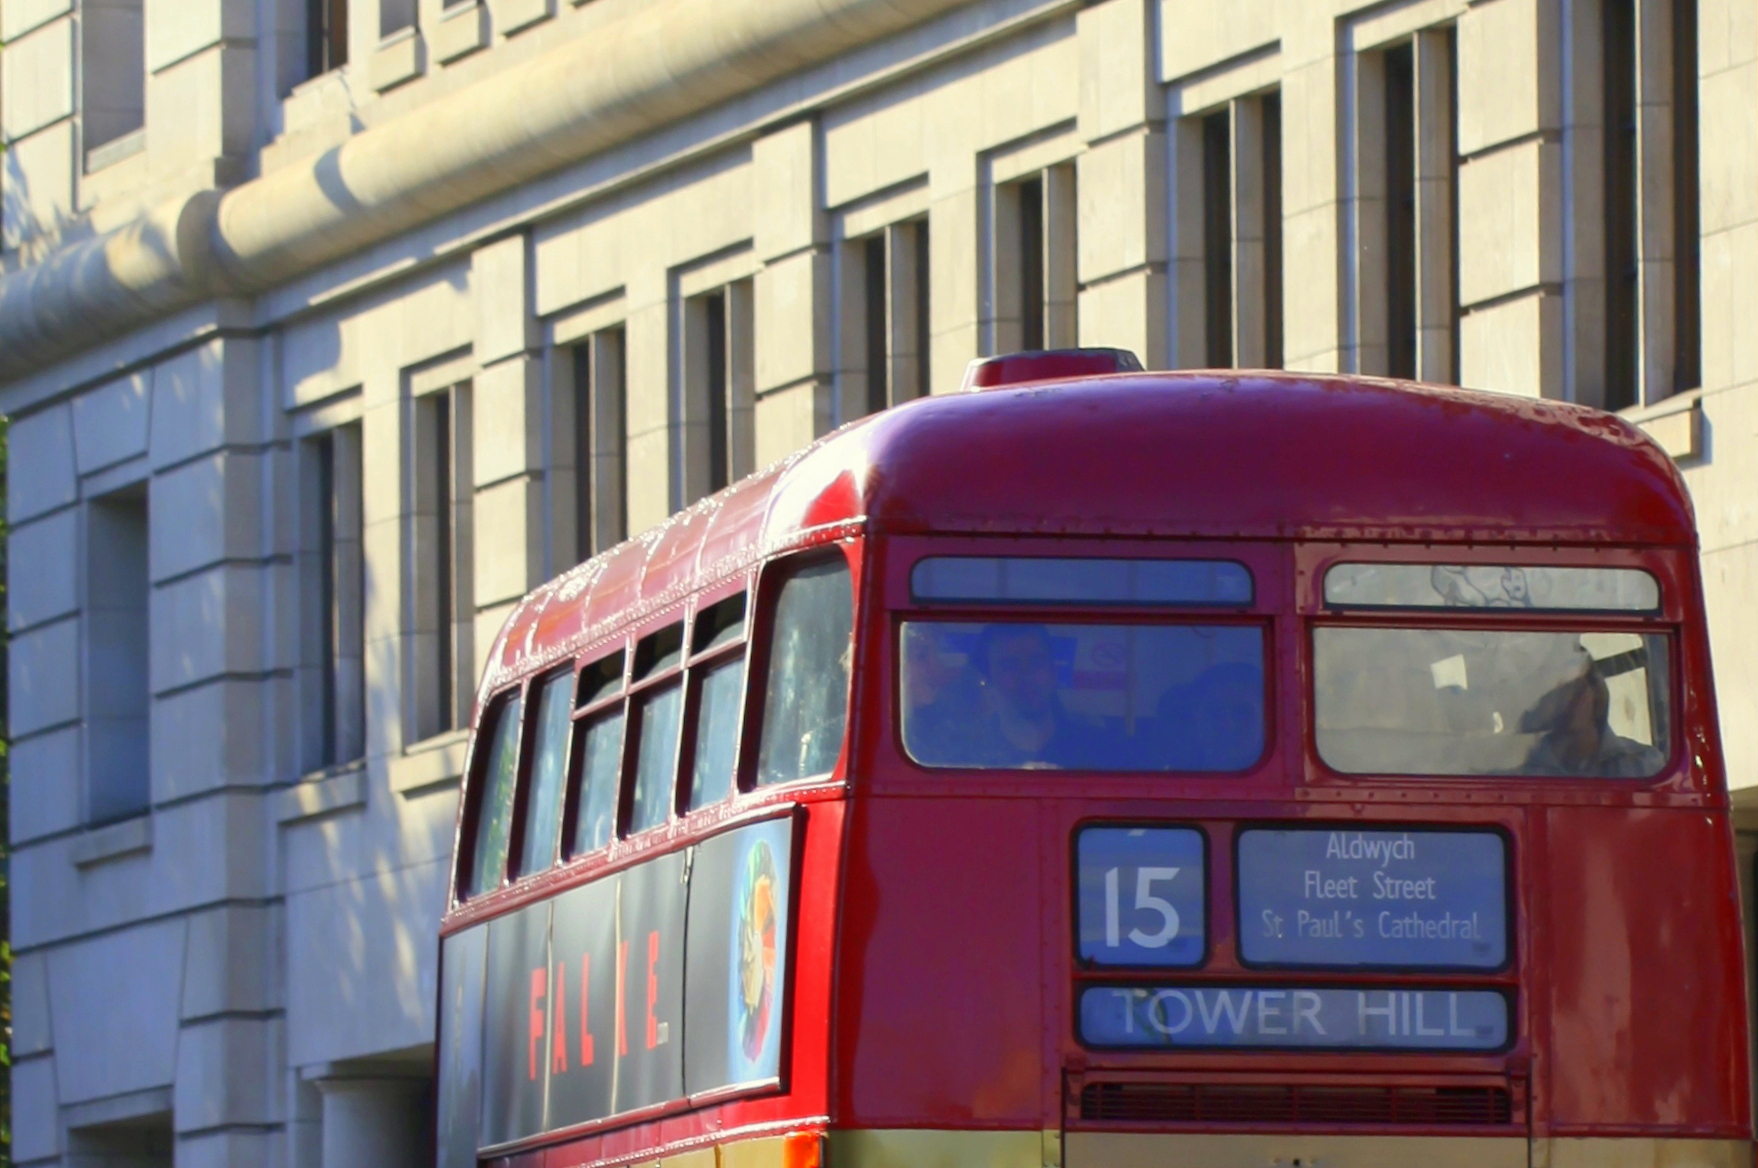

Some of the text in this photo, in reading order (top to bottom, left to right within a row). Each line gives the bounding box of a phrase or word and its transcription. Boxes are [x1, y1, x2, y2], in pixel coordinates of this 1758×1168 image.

[1325, 833, 1415, 868] Aldwych
[1304, 871, 1436, 901] Fleet Street
[1105, 866, 1181, 949] 15
[1262, 909, 1481, 940] St Paul's Cathedral
[1112, 988, 1477, 1037] TOWER HILL
